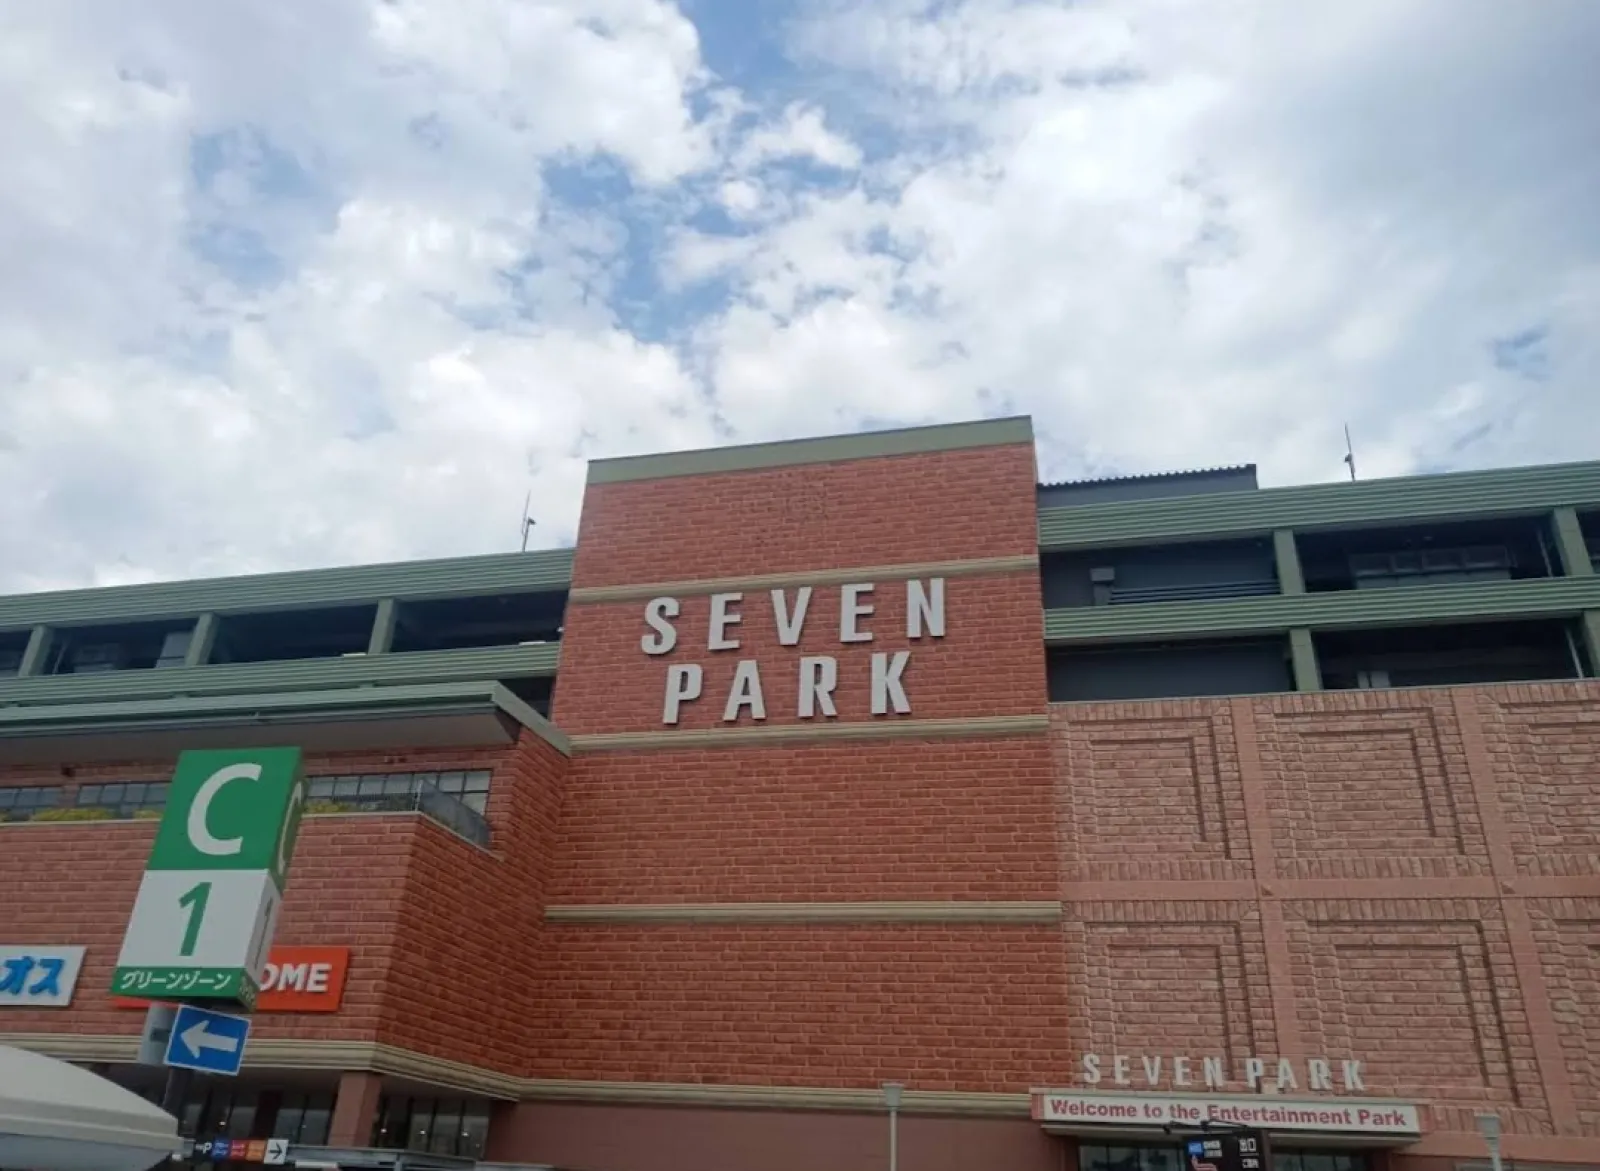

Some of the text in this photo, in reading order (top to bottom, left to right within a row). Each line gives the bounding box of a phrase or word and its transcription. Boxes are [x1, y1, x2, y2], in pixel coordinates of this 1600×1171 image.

[641, 578, 945, 654] SEVEN
[663, 651, 912, 724] PARK
[187, 763, 262, 856] C
[178, 882, 212, 957] 1
[0, 956, 65, 996] オス
[120, 973, 232, 991] グリーンゾーン
[1083, 1054, 1366, 1090] SEVEN PARK
[1051, 1099, 1406, 1126] Welcome to the Entertainment Park
